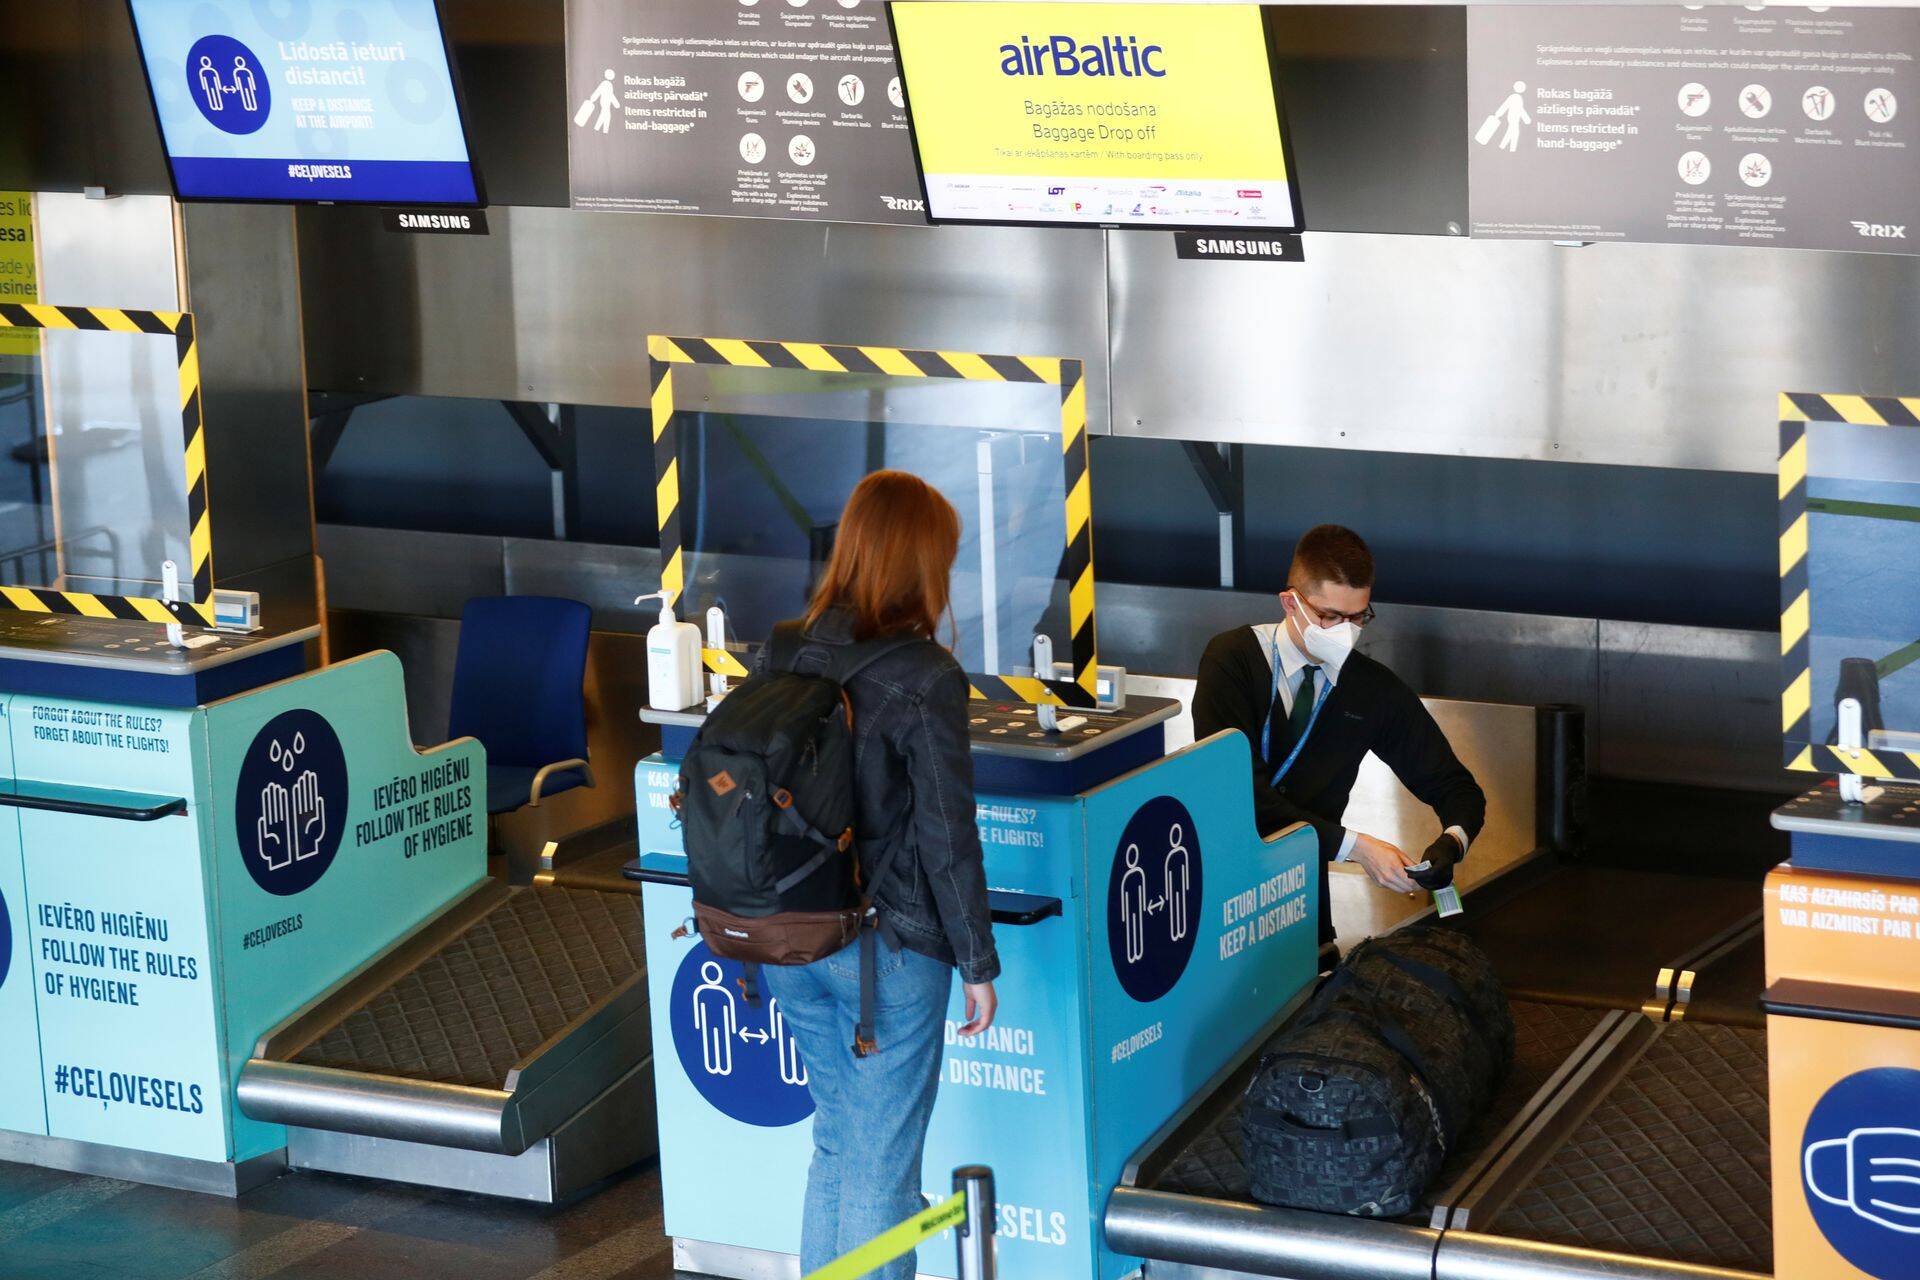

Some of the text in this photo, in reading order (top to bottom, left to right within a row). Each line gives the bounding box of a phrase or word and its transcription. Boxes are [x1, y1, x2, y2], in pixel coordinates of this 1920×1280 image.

[278, 41, 406, 61] Lidostā ieturi
[778, 52, 795, 60] could
[1000, 35, 1167, 77] airBaltic
[284, 65, 366, 85] distanci!
[624, 75, 686, 89] Rokas bagāžā
[624, 89, 663, 102] aizliegts
[1537, 87, 1613, 101] Rokas bagāžā
[625, 106, 708, 118] Items restricted in
[1024, 99, 1157, 118] Bagāžas nodošana
[1536, 104, 1584, 118] aizliegts
[1033, 123, 1157, 142] Baggage Drop off
[1537, 121, 1639, 135] Items restricted in
[399, 213, 471, 230] SAMSUNG
[1197, 239, 1283, 256] SAMSUNG
[32, 705, 162, 733] FORGOT ABOUT THE RULES?
[34, 725, 170, 753] FORGET ABOUT THE FLIGHTS!
[374, 757, 470, 811] IEVĒRO HIGIĒNU
[648, 771, 670, 788] KAS
[649, 792, 670, 808] VAR
[356, 785, 471, 847] FOLLOW THE RULES
[991, 805, 1037, 825] RULES?
[404, 813, 473, 859] OF HYGIENE
[991, 827, 1044, 848] FLIGHTS!
[1223, 862, 1305, 927] IETURI DISTANCI
[1780, 883, 1919, 916] KAS AIZMIRSĪS PAR
[38, 902, 168, 942] IEVĒRO HIGIĒNU
[243, 913, 303, 950] #CEĻOVESELS
[1219, 893, 1307, 961] KEEP A DISTANCE
[1779, 907, 1808, 928] VAR
[1811, 911, 1880, 936] AIZMIRST
[1883, 918, 1911, 939] PAR
[41, 937, 198, 980] FOLLOW THE RULES
[44, 971, 139, 1007] OF HYGIENE
[1111, 1021, 1163, 1064] #CEĻOVESELS
[949, 1058, 1047, 1095] DISTANCE
[54, 1064, 203, 1114] #CEĻOVESELS
